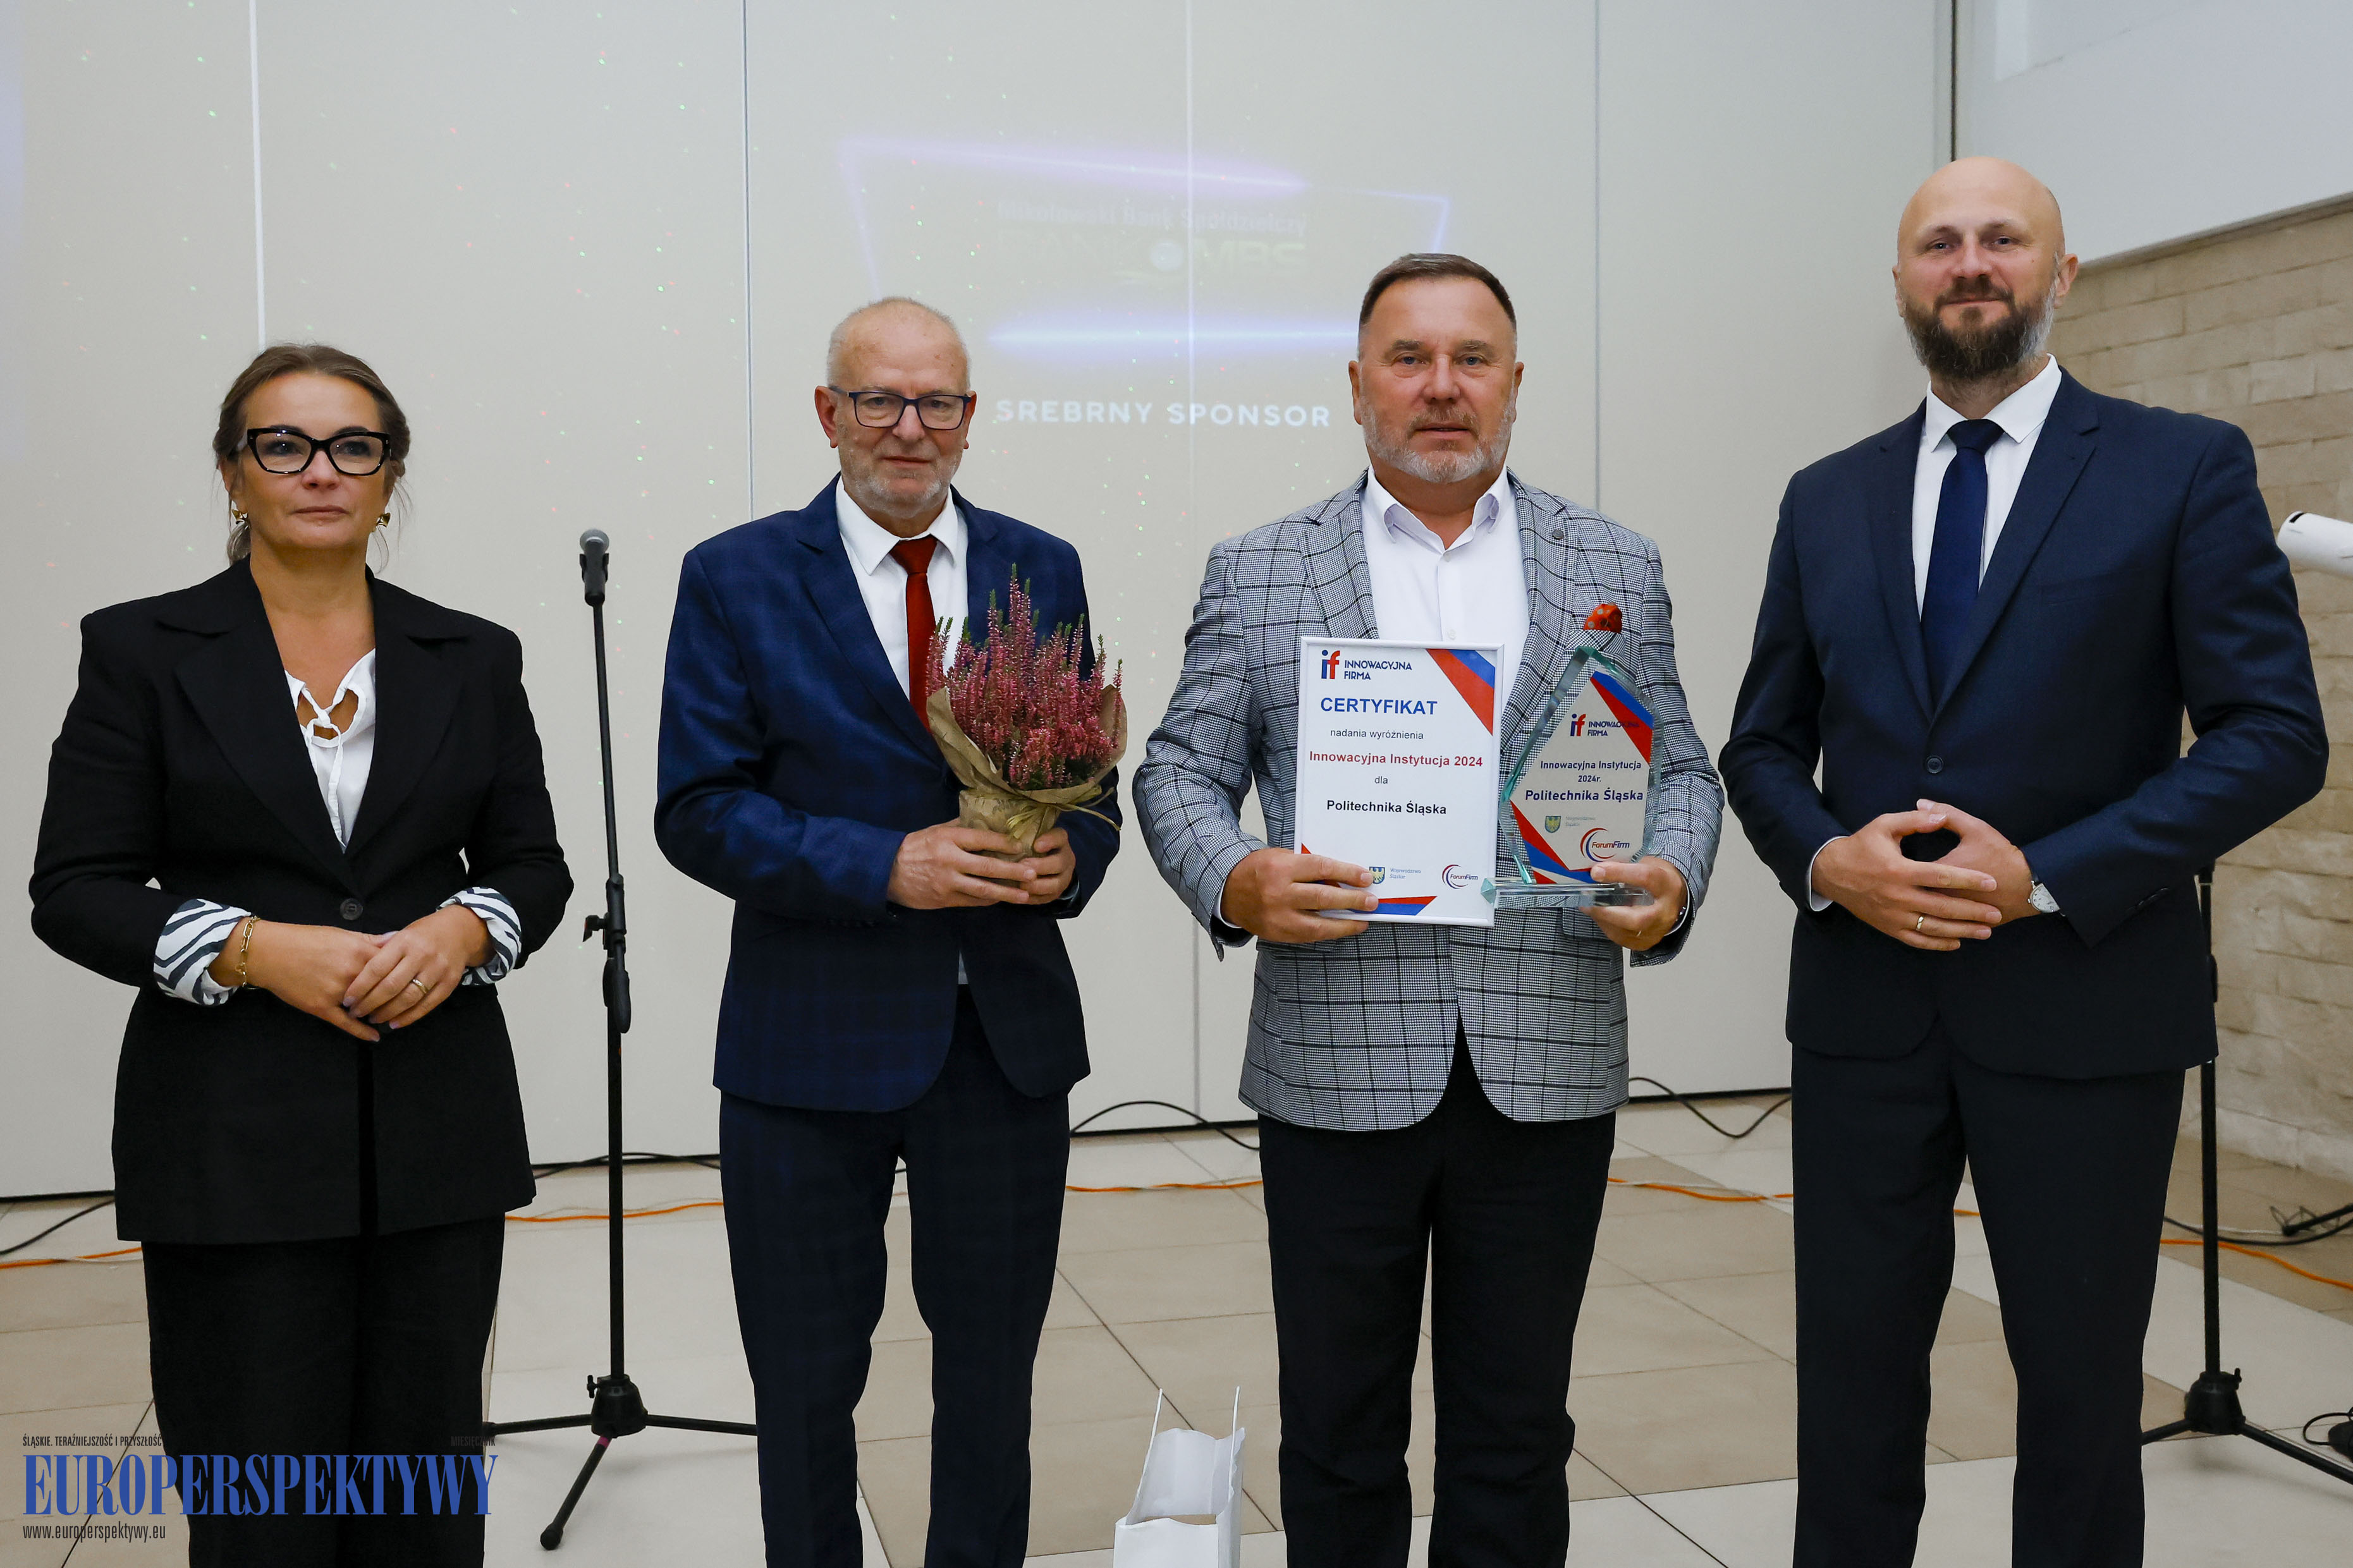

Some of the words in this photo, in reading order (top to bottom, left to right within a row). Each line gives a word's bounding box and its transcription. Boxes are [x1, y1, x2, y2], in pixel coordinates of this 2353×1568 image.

[996, 399, 1152, 424] SREBRNY
[1167, 403, 1330, 427] SPONSOR
[1344, 660, 1412, 671] INNOWACYJNA
[1344, 671, 1371, 680] FIRMA
[1321, 697, 1438, 715] CERTYFIKAT
[1330, 728, 1367, 738] nadania
[1369, 729, 1424, 741] wyróżnienia
[1310, 751, 1386, 766] Innowacyjna
[1390, 753, 1450, 768] Instytucja
[1454, 756, 1483, 767] 2024
[1541, 760, 1595, 770] Innowacyjna
[1599, 761, 1641, 770] Instytucja
[1374, 775, 1388, 784] dla
[1525, 790, 1599, 801] Politechnika
[1604, 787, 1643, 803] Śląska
[1327, 799, 1402, 813] Politechnika
[1406, 800, 1446, 816] Śląska
